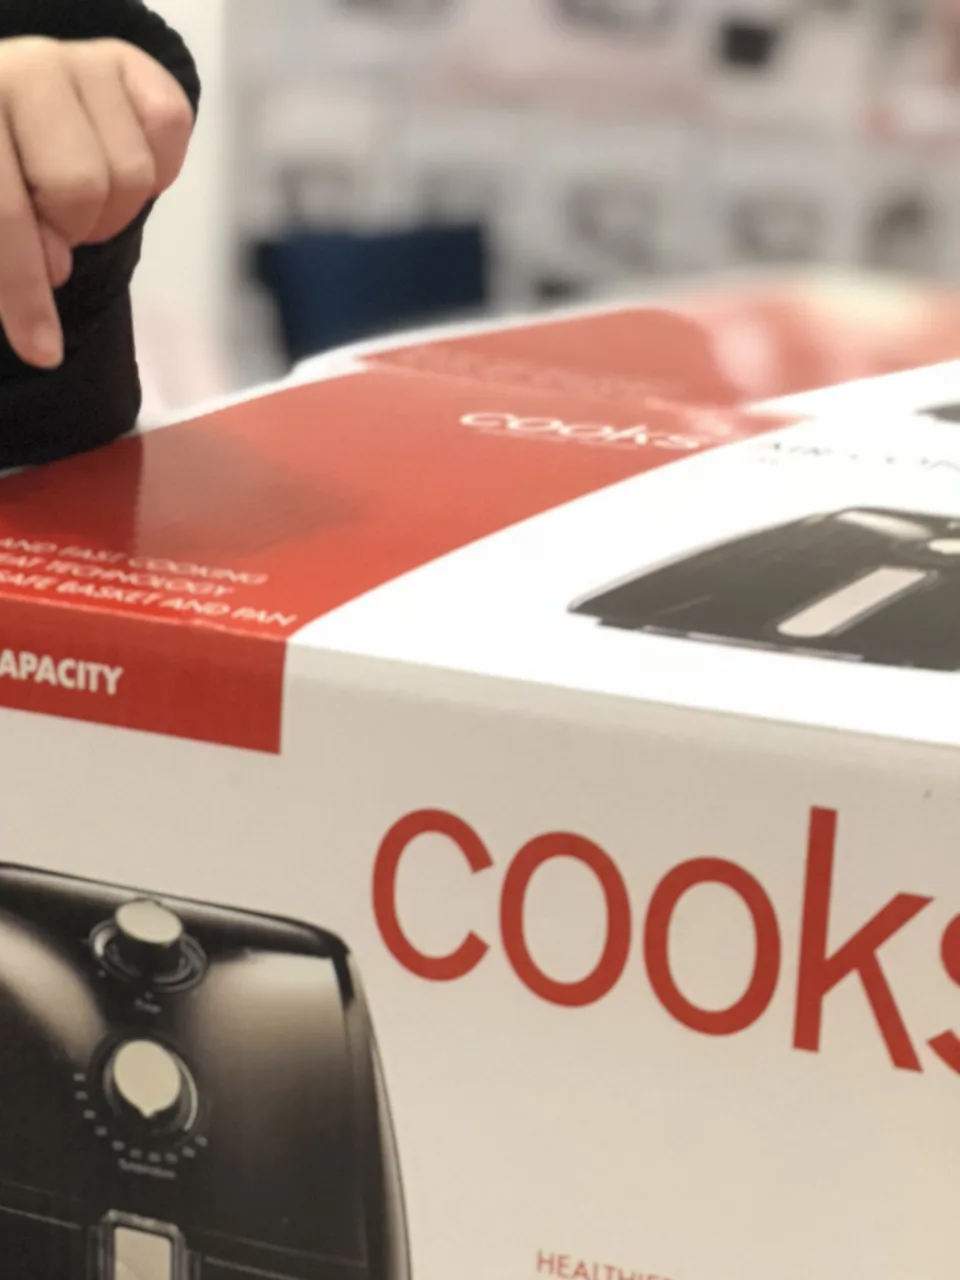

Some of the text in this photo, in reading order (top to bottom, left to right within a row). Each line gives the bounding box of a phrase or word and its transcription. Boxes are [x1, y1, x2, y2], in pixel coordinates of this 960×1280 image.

[460, 412, 699, 449] cooks
[159, 596, 231, 615] AND
[230, 605, 298, 627] PAN
[372, 805, 960, 1077] cook
